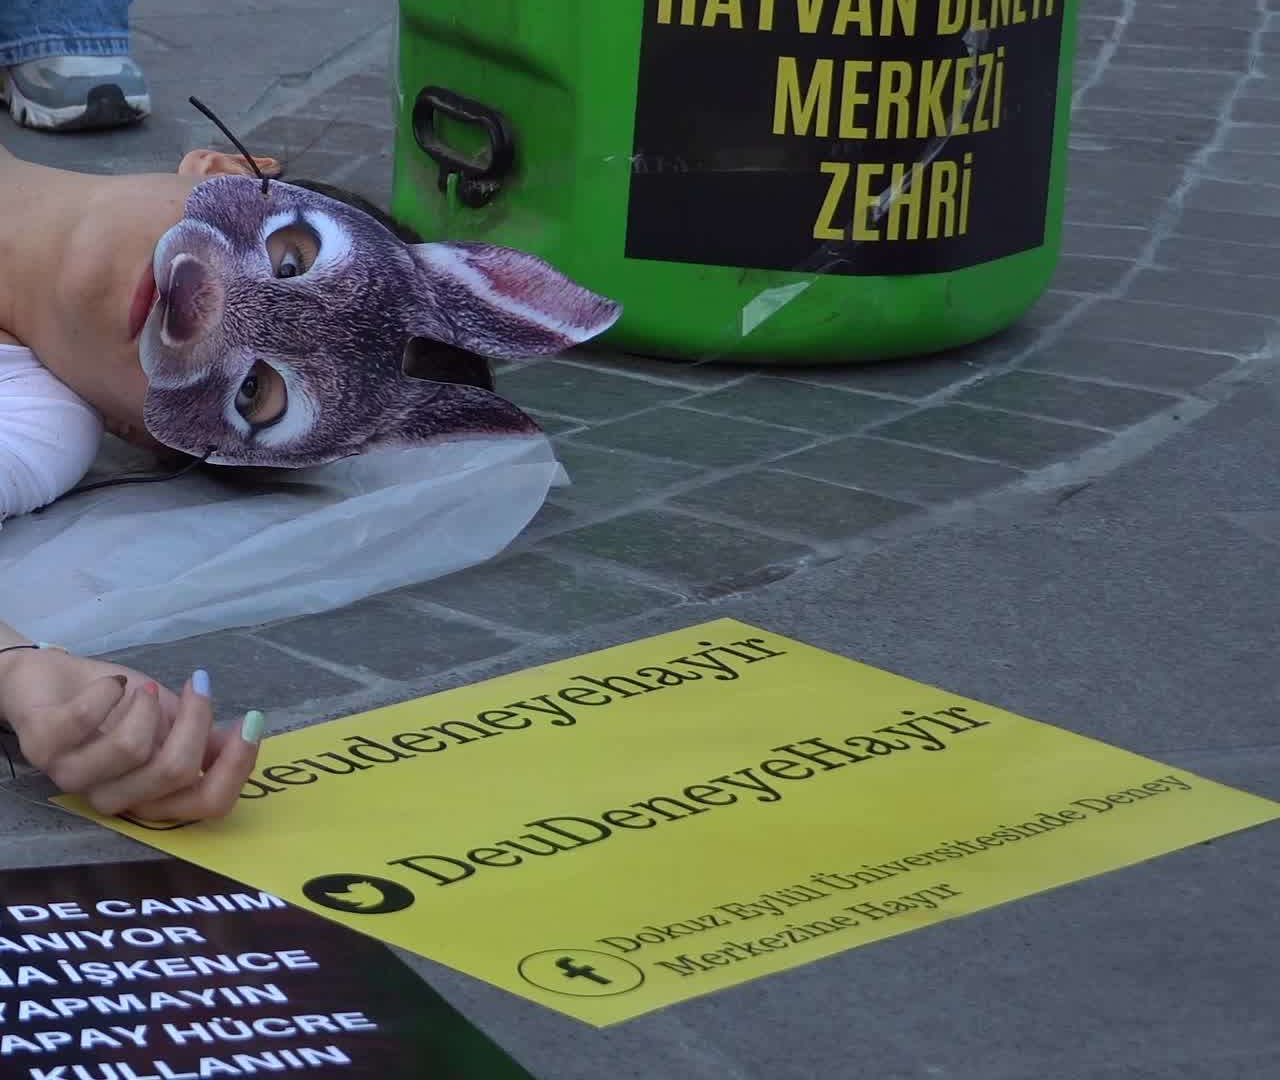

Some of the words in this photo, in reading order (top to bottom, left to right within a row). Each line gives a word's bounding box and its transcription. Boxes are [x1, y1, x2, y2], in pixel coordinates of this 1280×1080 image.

[772, 46, 1005, 139] MERKEZİ
[813, 152, 973, 242] ZEHRİ
[386, 706, 991, 886] DeuDeneyeHayir
[7, 902, 88, 921] DE
[96, 892, 287, 918] CANIM
[596, 914, 732, 953] Dokuz
[715, 884, 832, 920] Eylül
[809, 807, 1086, 891] Üniversitesinde
[1071, 775, 1193, 813] Deney
[57, 950, 320, 986] İŞKENCE
[653, 914, 860, 976] Merkezine
[843, 883, 964, 920] Hayır
[29, 1045, 352, 1080] KULLANIN
[162, 1012, 377, 1047] HÜCRE
